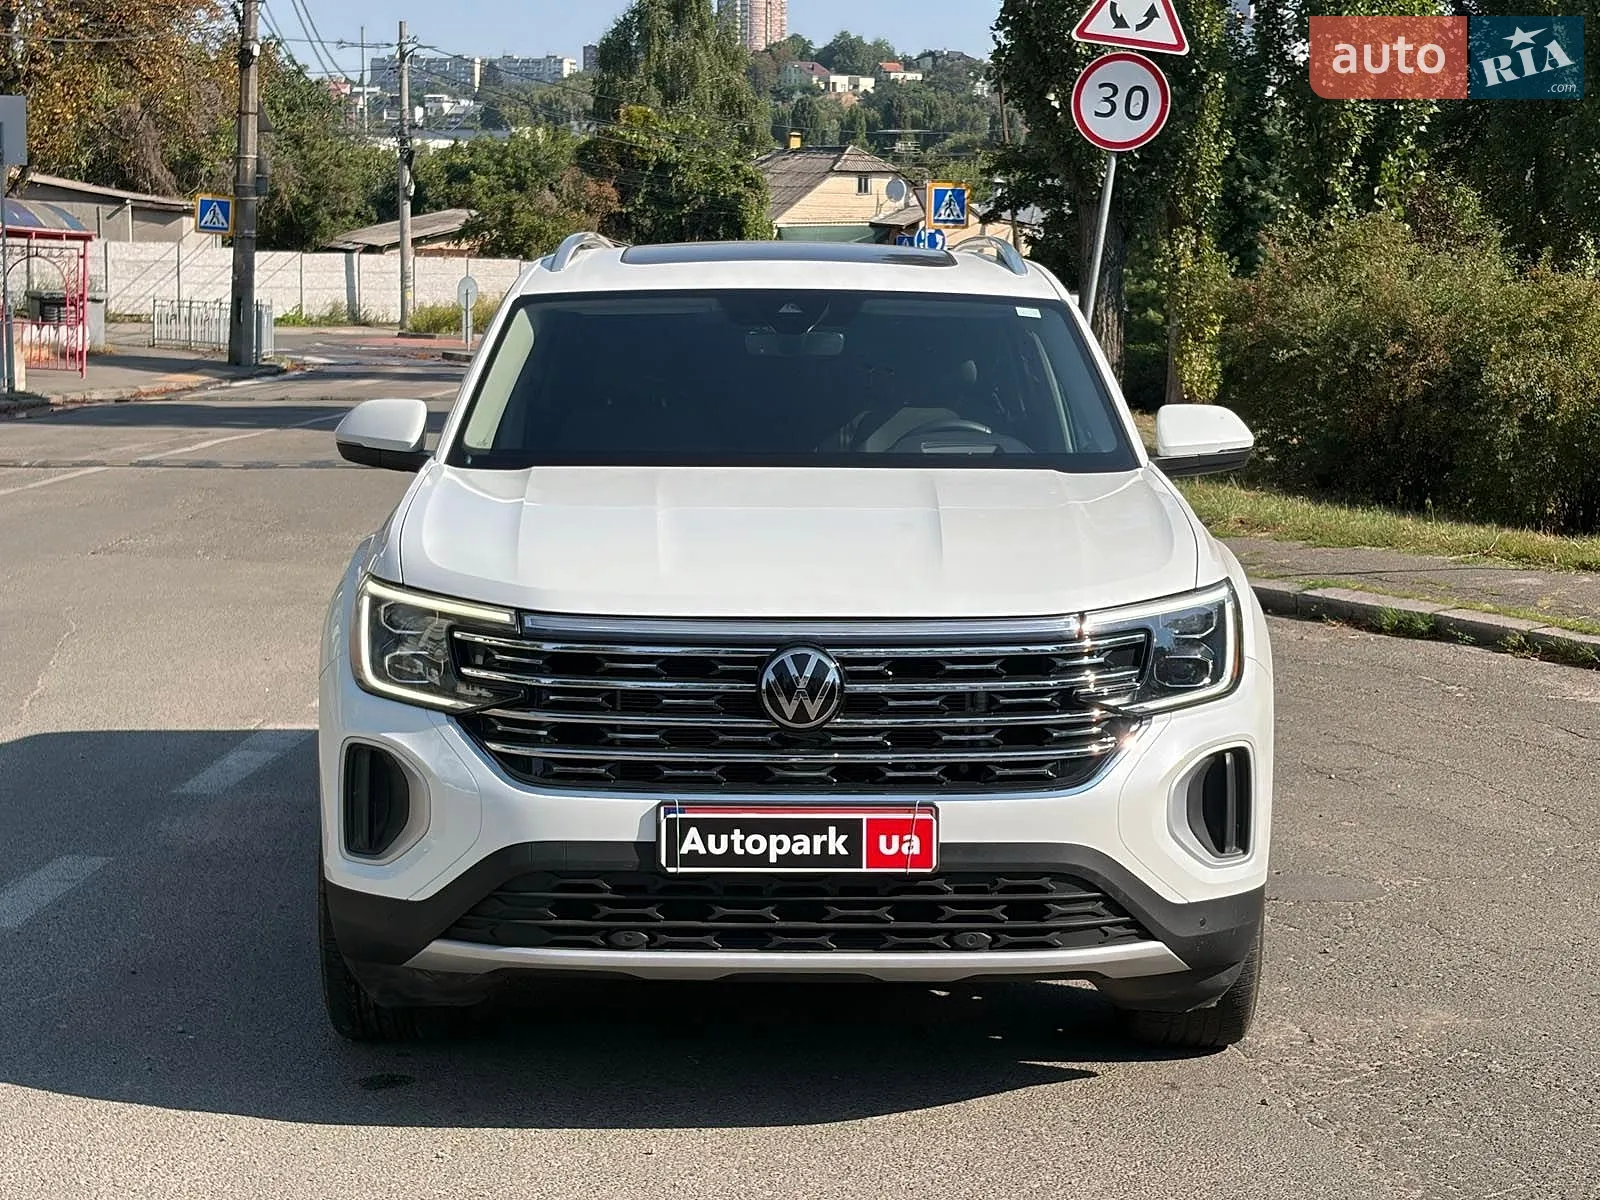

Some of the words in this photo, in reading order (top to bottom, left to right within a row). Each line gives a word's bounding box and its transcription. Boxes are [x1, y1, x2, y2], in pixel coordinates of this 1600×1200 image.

[1094, 82, 1149, 121] 30
[680, 826, 849, 863] Autopark
[879, 833, 921, 855] ua
